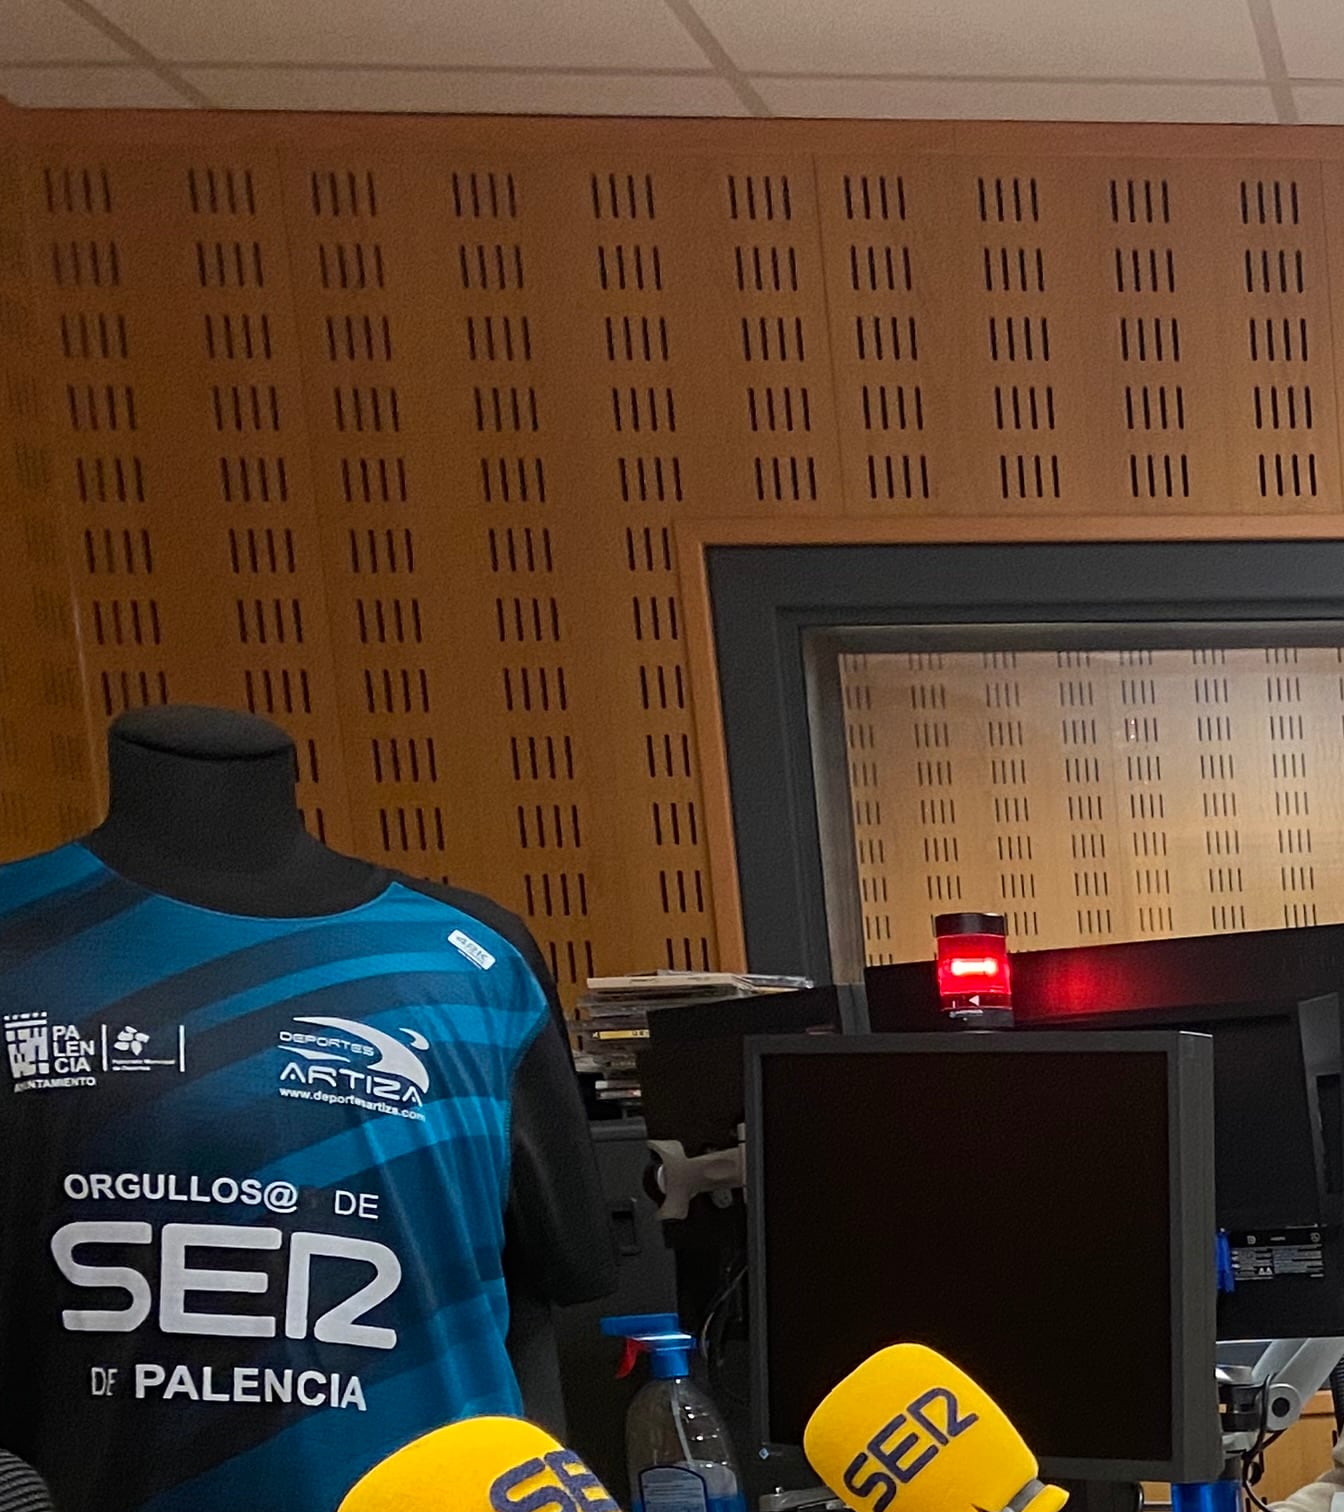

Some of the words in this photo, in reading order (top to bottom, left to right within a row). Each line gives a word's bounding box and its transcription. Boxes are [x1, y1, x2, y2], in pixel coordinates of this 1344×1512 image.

[52, 1024, 80, 1041] PA
[53, 1040, 95, 1057] LEN
[279, 1031, 375, 1057] DEPORTES
[54, 1056, 91, 1074] CIA
[279, 1062, 423, 1108] ARTIZA
[279, 1087, 426, 1122] www.deportesartiza.com
[64, 1173, 299, 1213] ORGULLOS@
[334, 1190, 379, 1219] DE
[50, 1220, 402, 1350] SER
[91, 1367, 117, 1396] DE
[134, 1363, 367, 1412] PALENCIA
